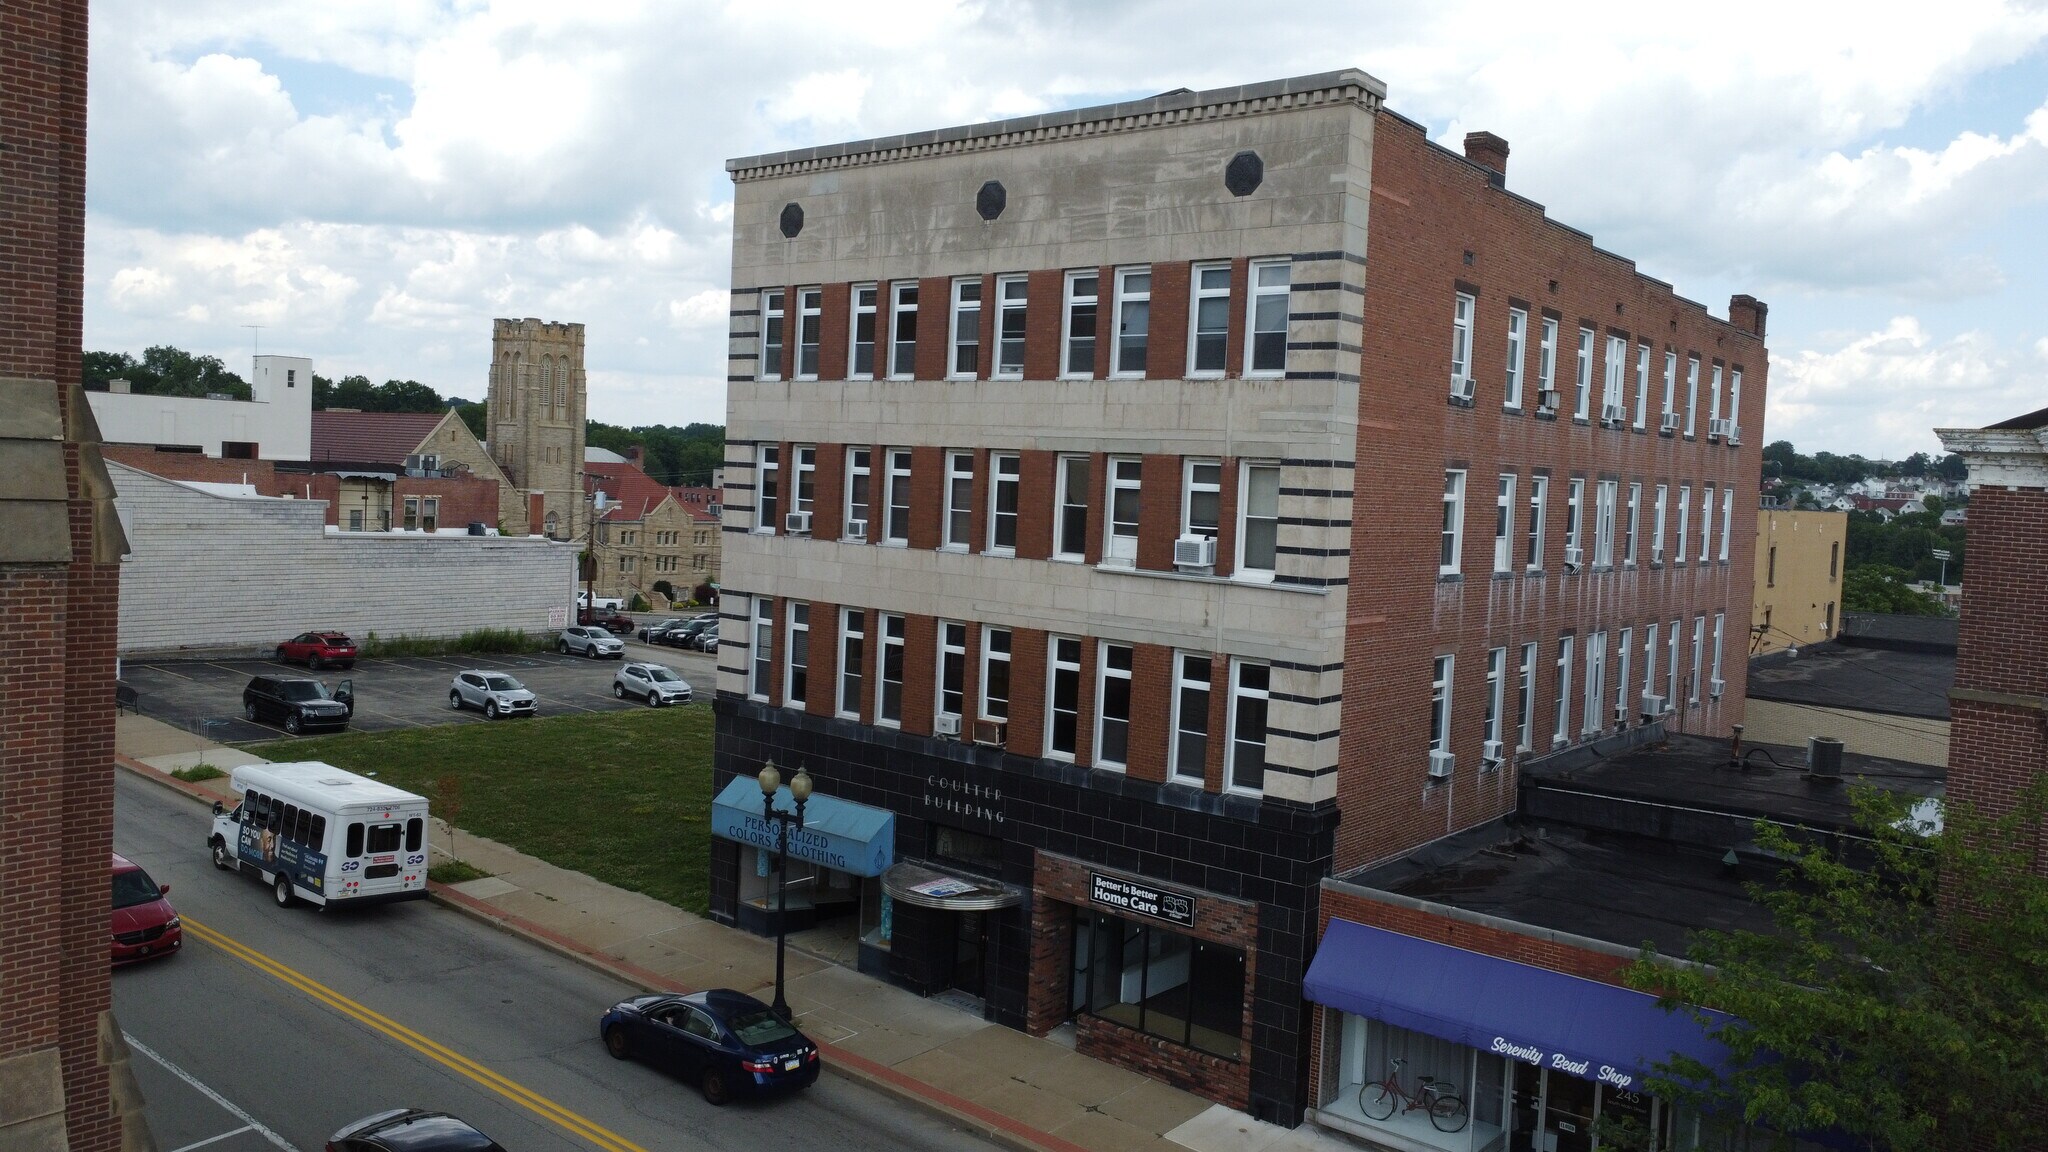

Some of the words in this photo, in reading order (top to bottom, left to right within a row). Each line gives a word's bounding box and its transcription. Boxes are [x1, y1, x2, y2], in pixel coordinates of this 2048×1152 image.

[928, 775, 1001, 800] COULTER
[925, 794, 1004, 823] BUILDING
[241, 835, 252, 846] CAN
[242, 825, 251, 836] SO
[250, 828, 261, 840] YOU
[745, 816, 828, 849] PERSOALIZED
[240, 845, 249, 854] DO
[729, 825, 772, 848] COLORS
[786, 841, 845, 868] CLOTHING
[341, 861, 359, 871] GO
[407, 855, 424, 864] GO
[1094, 887, 1128, 906] Home
[1130, 896, 1158, 914] Care
[1095, 876, 1122, 892] Better
[1130, 885, 1158, 901] Better
[1491, 1036, 1543, 1066] Serenity
[1552, 1053, 1589, 1075] Bead
[1597, 1065, 1632, 1088] Shop
[1615, 1088, 1640, 1104] 245
